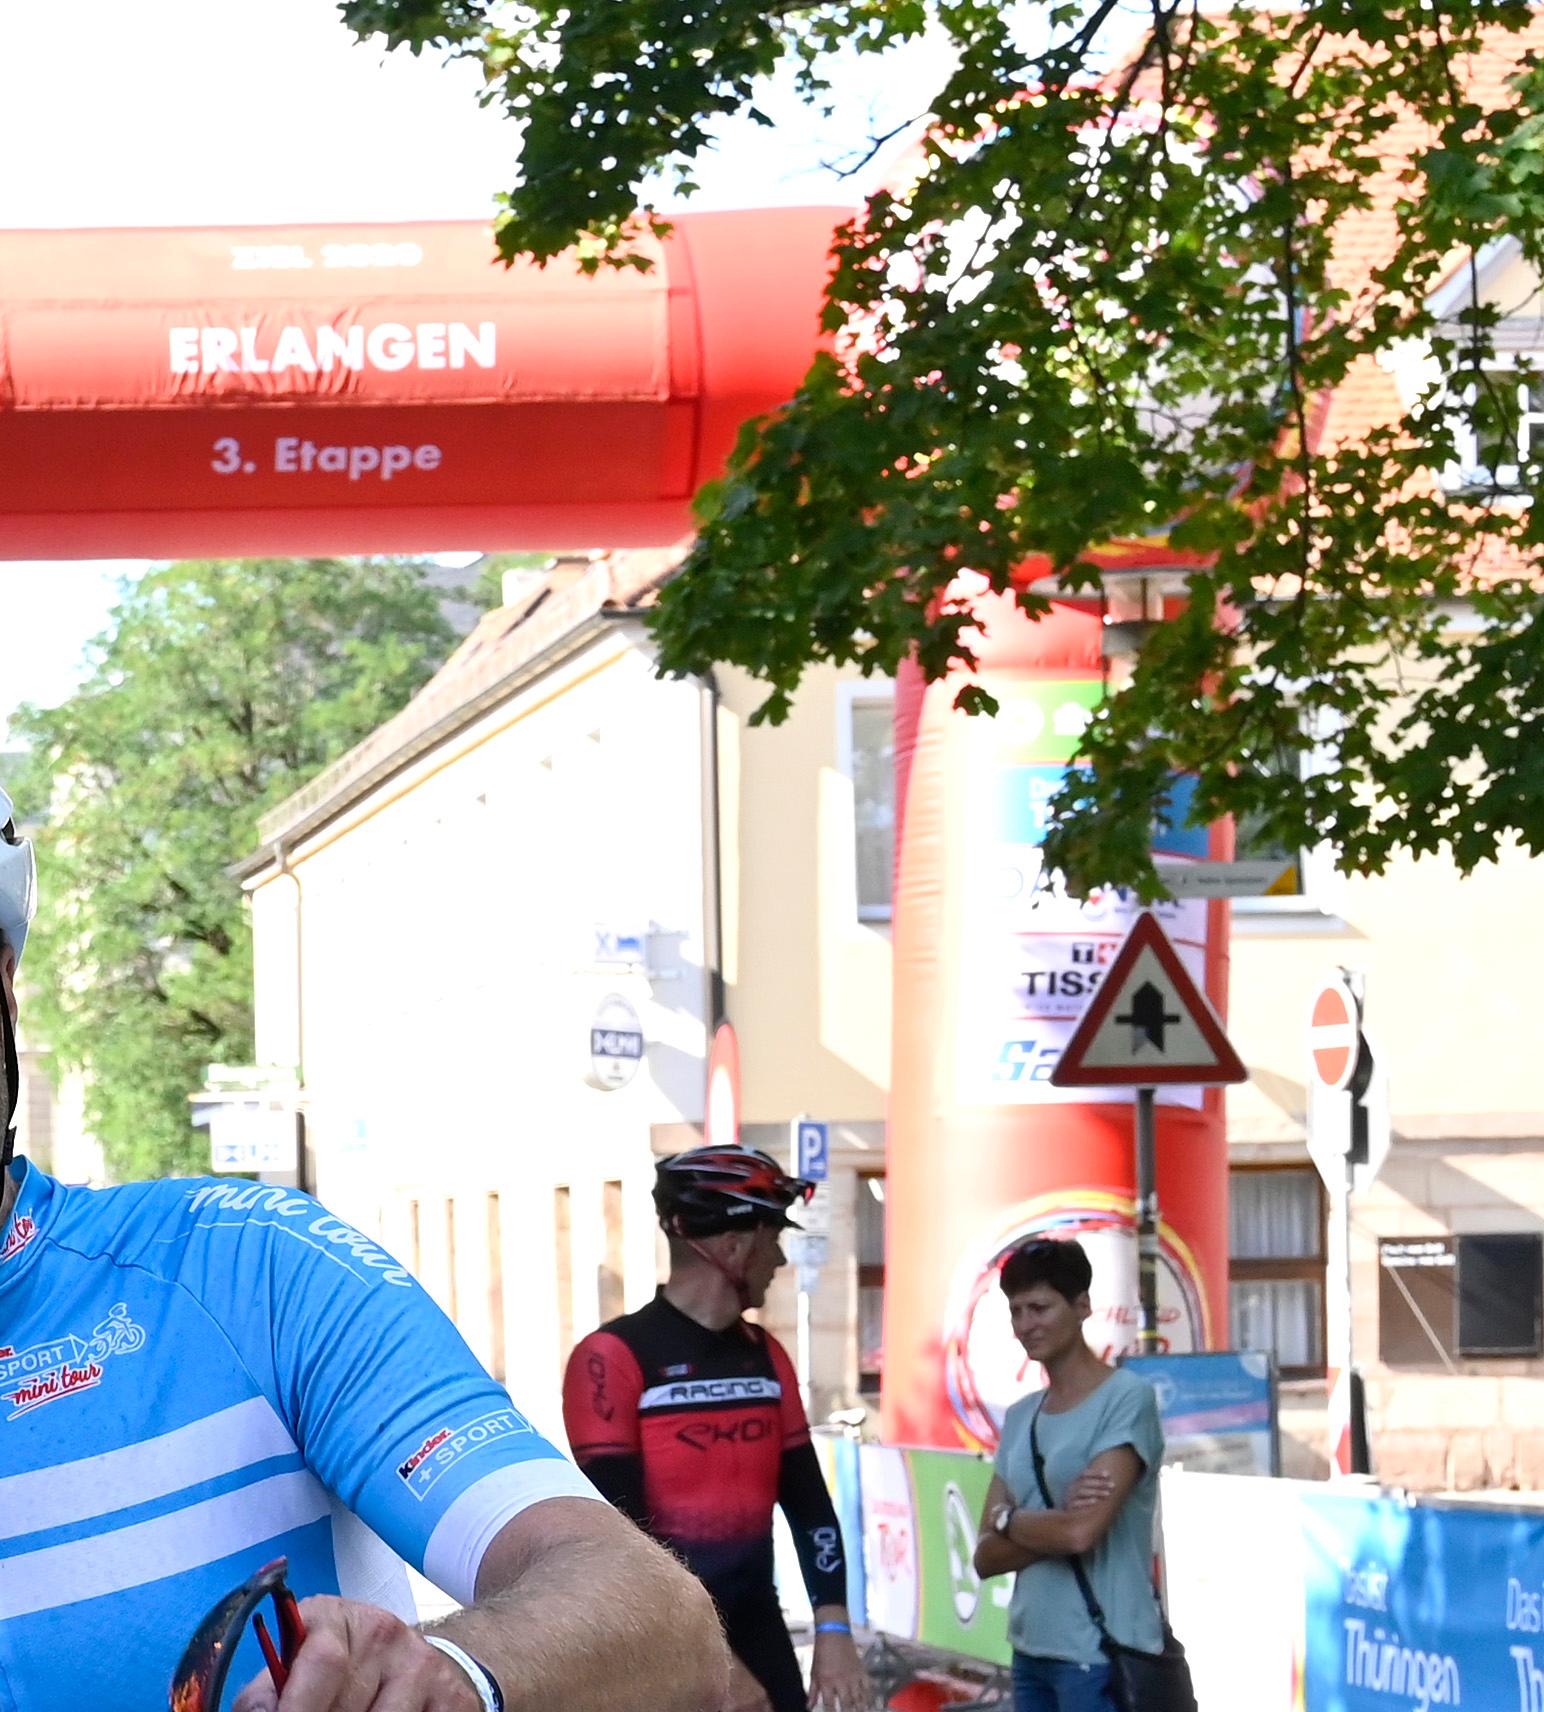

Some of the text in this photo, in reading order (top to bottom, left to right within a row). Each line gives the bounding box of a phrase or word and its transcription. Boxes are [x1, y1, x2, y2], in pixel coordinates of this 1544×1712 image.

[169, 321, 497, 373] ERLANGEN
[211, 436, 443, 480] 3. Etappe
[1023, 971, 1109, 997] TISS
[801, 1128, 822, 1172] P
[7, 1364, 101, 1405] mini tour
[435, 1415, 515, 1465] SPORT
[1506, 1577, 1541, 1633] Das
